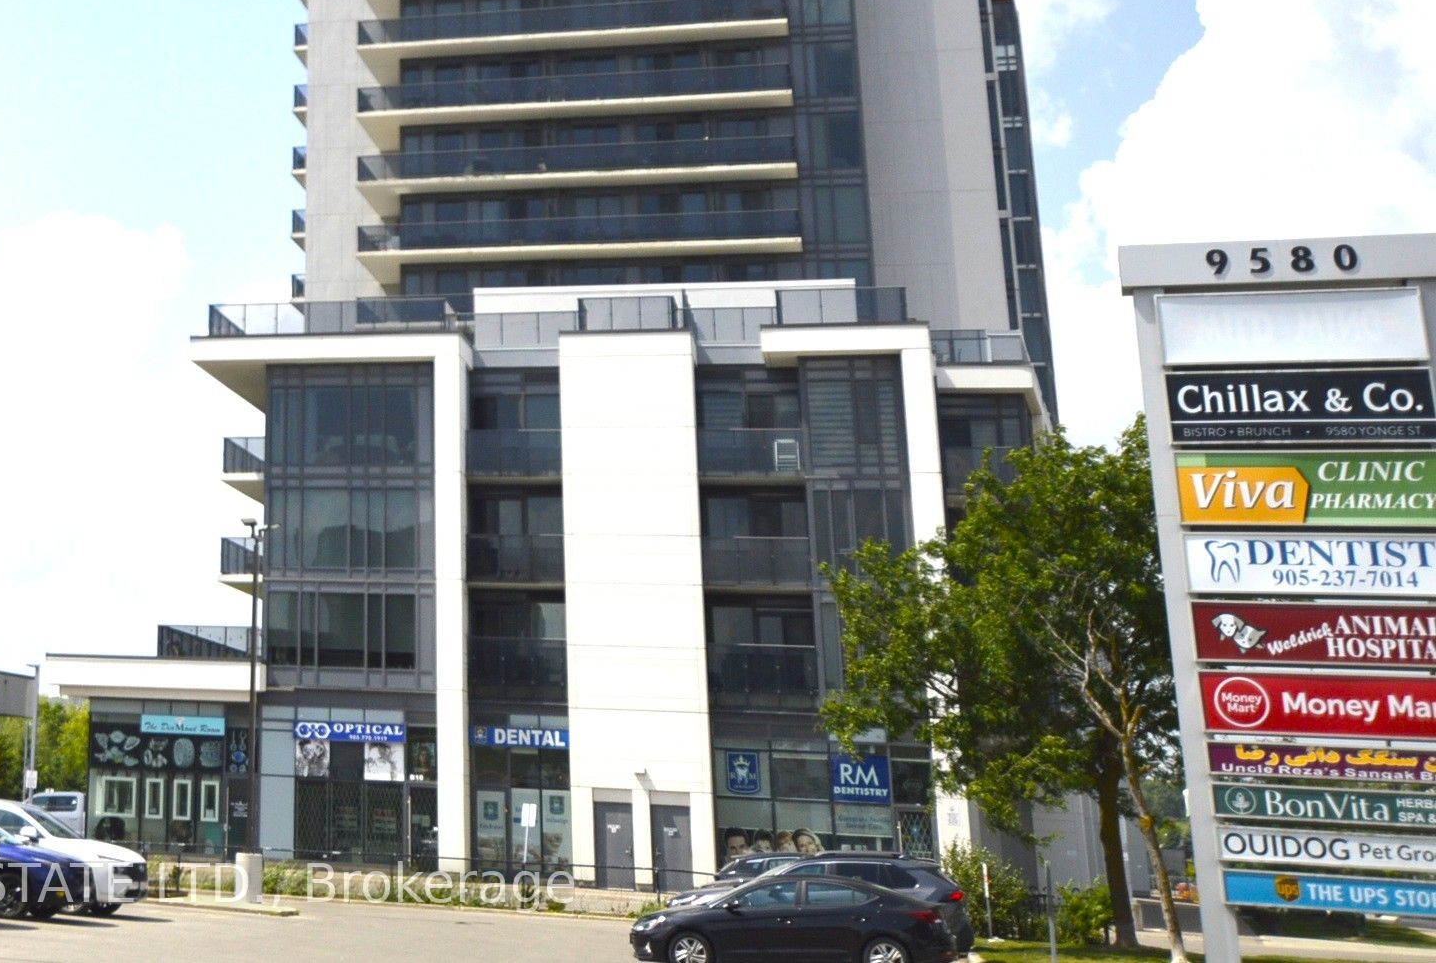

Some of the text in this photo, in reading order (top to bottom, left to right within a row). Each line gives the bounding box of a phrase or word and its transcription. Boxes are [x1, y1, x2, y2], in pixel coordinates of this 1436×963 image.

[1205, 244, 1358, 275] 9580
[1177, 383, 1424, 413] Chillax & Co.
[1237, 426, 1292, 437] BRUNCH
[1325, 425, 1357, 437] 9580
[1358, 425, 1405, 436] YONGE
[1317, 461, 1426, 482] CLINIC
[1190, 470, 1295, 509] Viva
[1310, 492, 1436, 509] PHARMACY
[1245, 539, 1436, 568] DENTIST
[1272, 569, 1419, 588] 905-237-7014
[1267, 622, 1334, 655] Weldrick
[1221, 692, 1262, 706] Money
[1227, 702, 1255, 713] Mart
[1281, 692, 1379, 722] Money
[333, 723, 403, 736] OPTICAL
[494, 728, 566, 747] DENTAL
[839, 763, 879, 785] RM
[1221, 763, 1273, 774] Uncle
[1278, 765, 1340, 777] Reza's
[834, 787, 888, 797] DENTISTRY
[1264, 789, 1390, 821] BonVita
[1398, 811, 1425, 823] SPA
[1224, 832, 1350, 860] OUIDOG
[1358, 843, 1391, 860] Pet
[1306, 883, 1343, 901] THE
[1348, 887, 1389, 904] UPS
